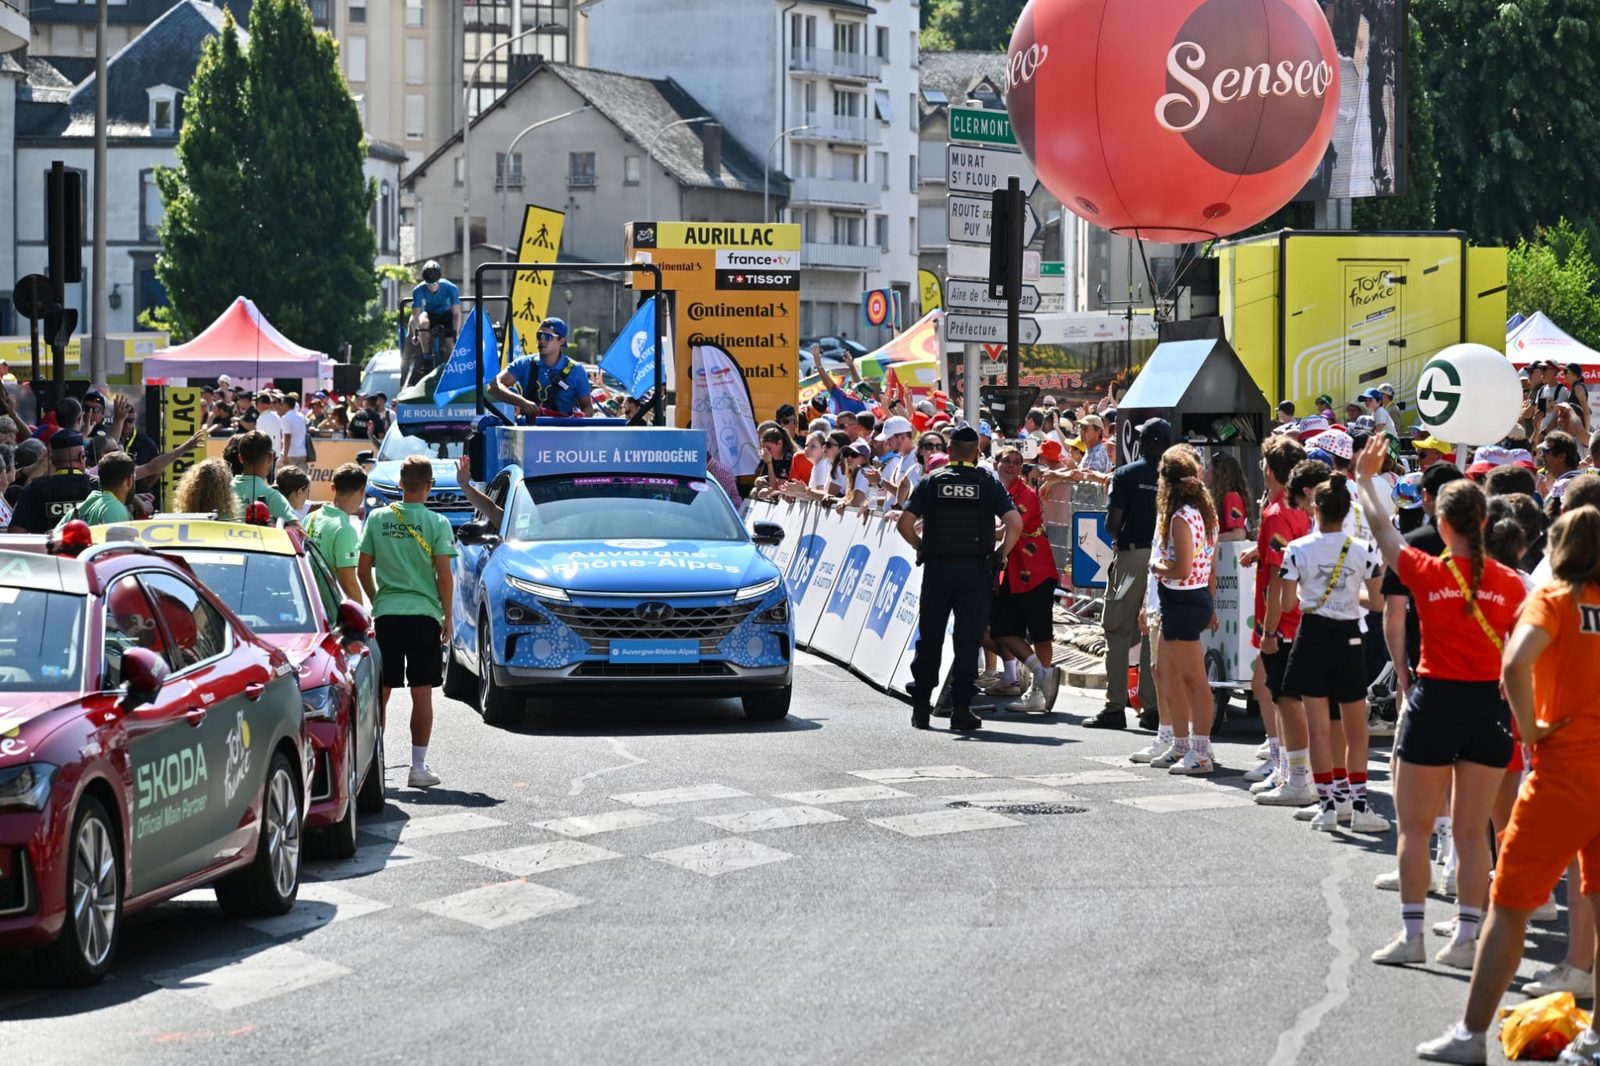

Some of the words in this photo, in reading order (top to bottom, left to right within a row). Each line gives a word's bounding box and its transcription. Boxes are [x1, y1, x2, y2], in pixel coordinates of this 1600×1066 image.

[1154, 41, 1334, 132] Senseo
[953, 115, 1010, 137] CLERMONT
[952, 152, 985, 169] MURAT
[966, 172, 997, 188] FLOUR
[952, 202, 980, 219] ROUTE
[684, 227, 774, 246] AURILLAC
[964, 221, 980, 237] PUY
[746, 275, 792, 285] TISSOT
[951, 286, 968, 301] Aire
[969, 288, 980, 302] de
[687, 302, 775, 321] Continental
[950, 320, 997, 337] Préfecture
[402, 409, 413, 418] JE
[414, 409, 446, 418] ROULE
[535, 450, 552, 464] JE
[555, 449, 608, 464] ROULE
[612, 446, 621, 463] À
[942, 485, 975, 498] CRS
[50, 502, 75, 516] CR
[140, 522, 206, 544] CL
[227, 528, 260, 540] LCL
[1428, 591, 1441, 603] La
[1438, 586, 1465, 600] Vac
[1476, 589, 1494, 601] qui
[622, 648, 698, 657] Auvergne-Rhône-Alpes
[137, 809, 163, 840] Official
[164, 801, 182, 828] Main
[182, 794, 208, 819] Partner
